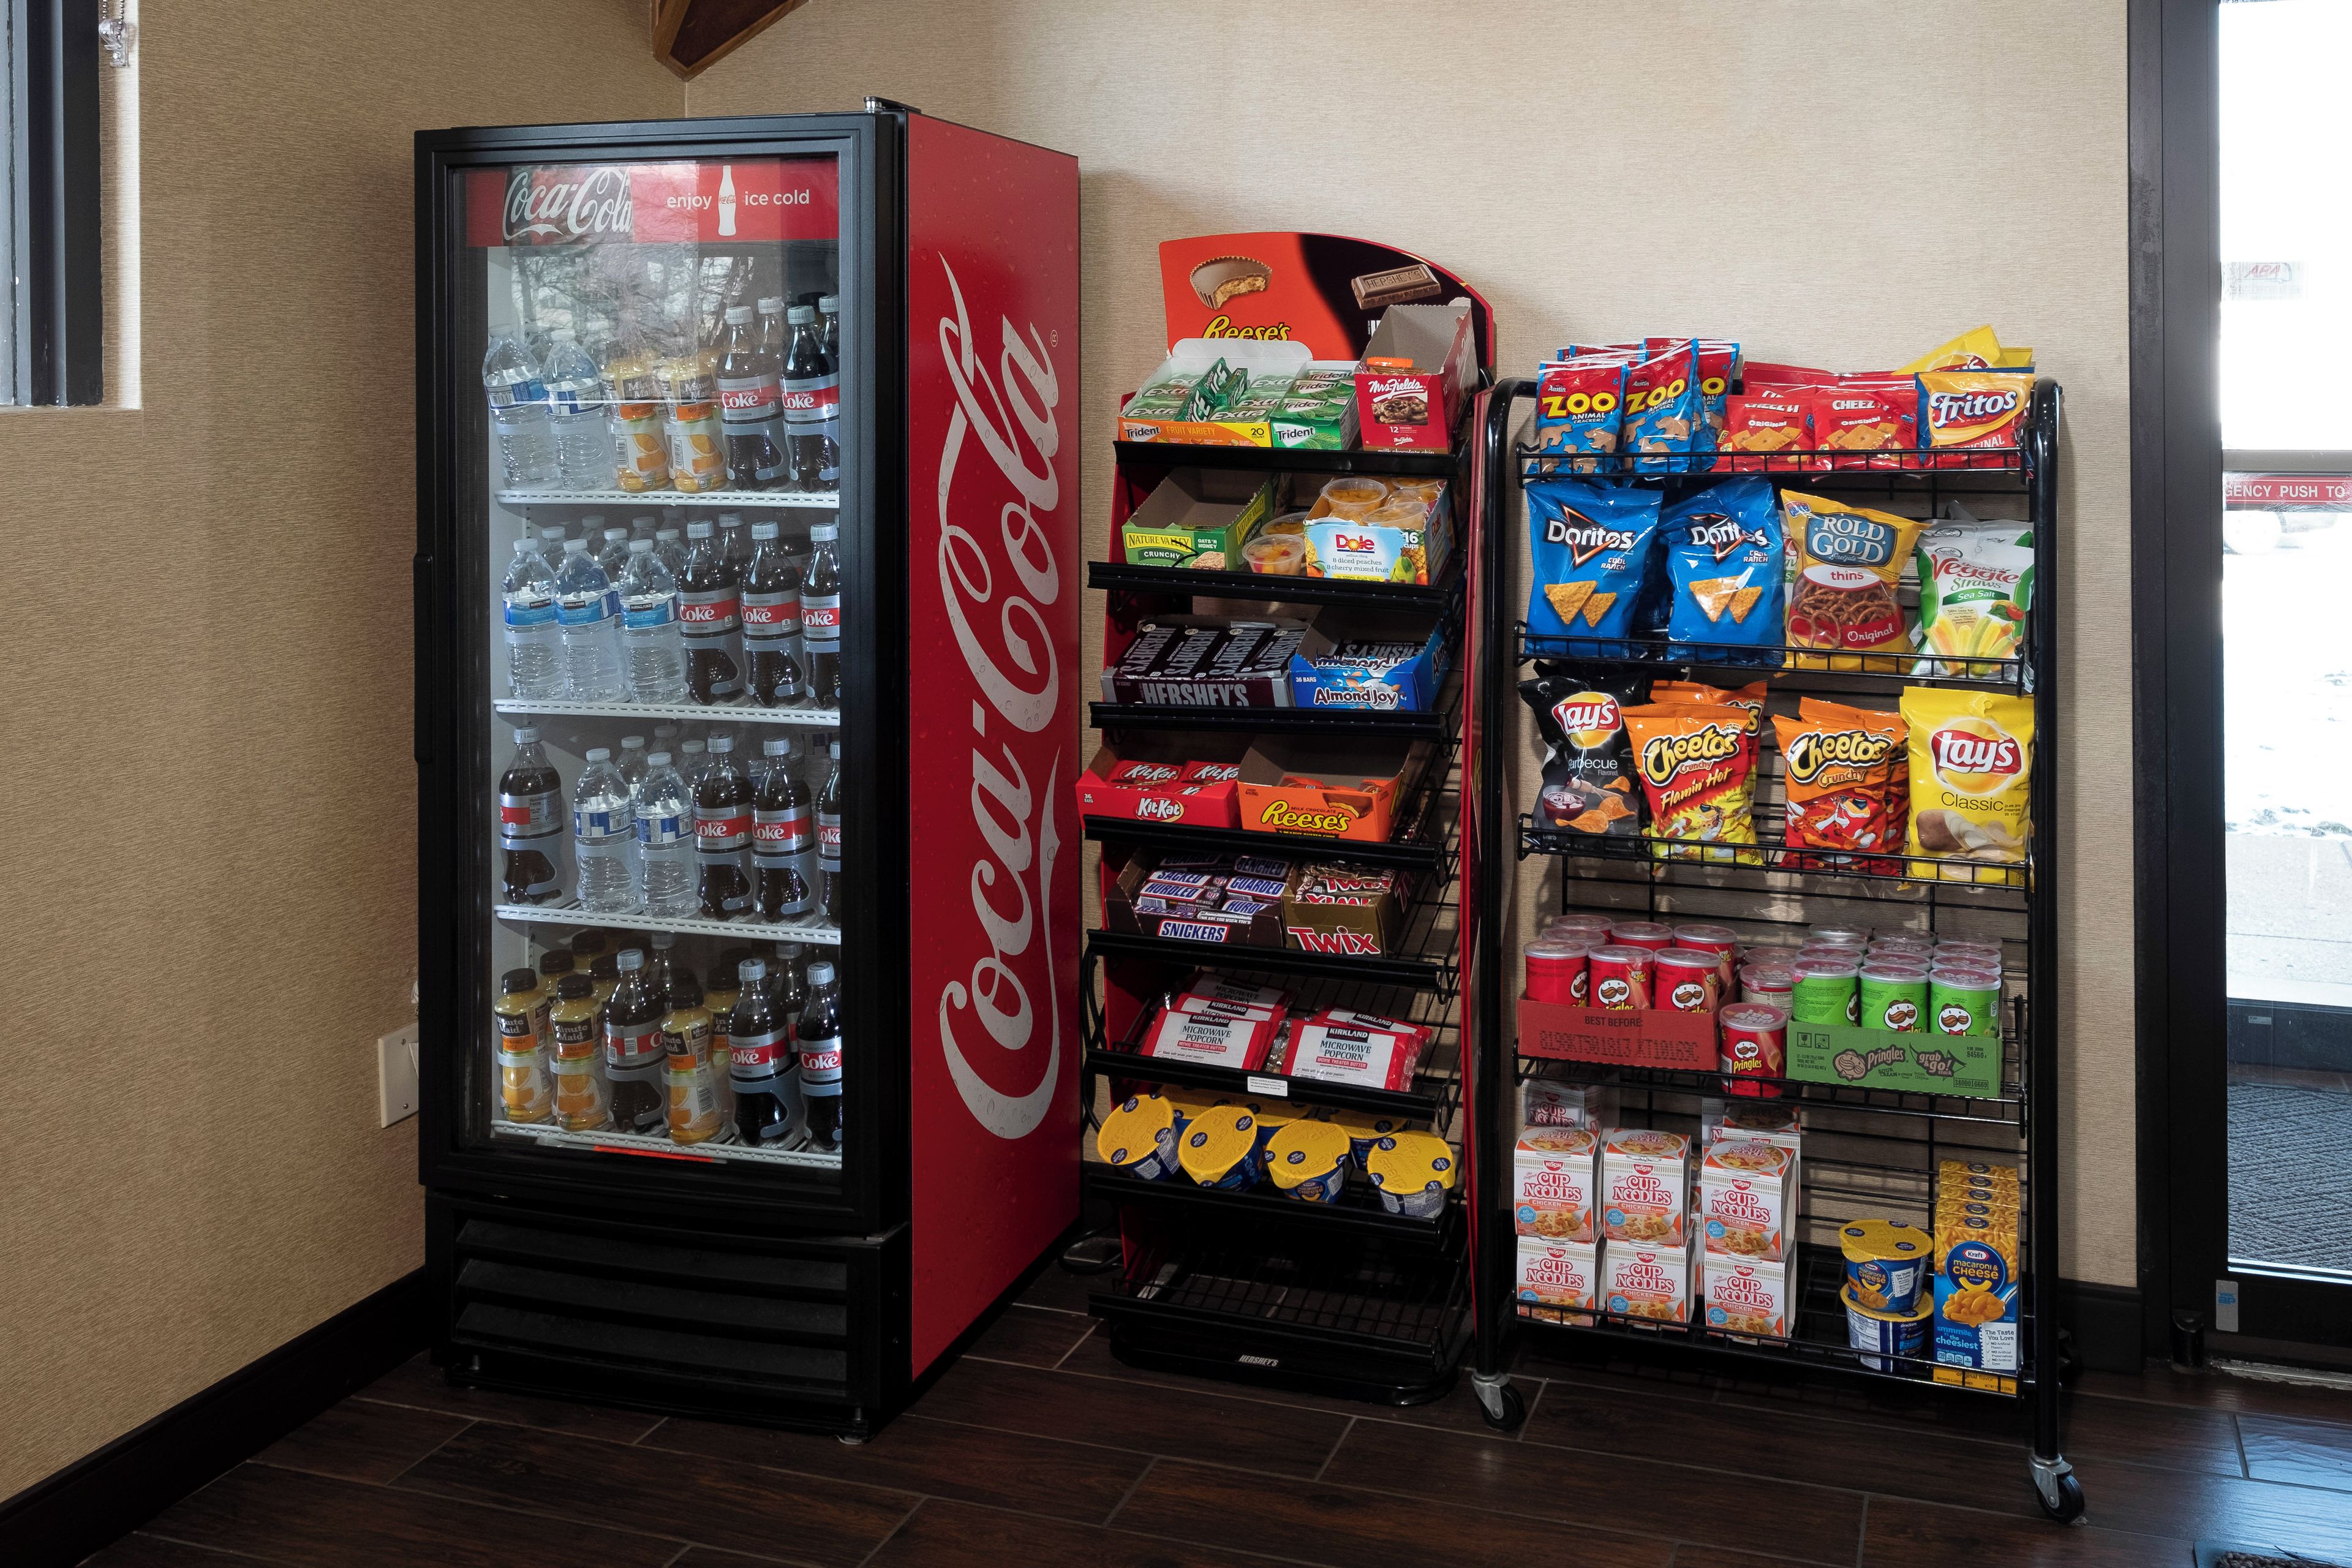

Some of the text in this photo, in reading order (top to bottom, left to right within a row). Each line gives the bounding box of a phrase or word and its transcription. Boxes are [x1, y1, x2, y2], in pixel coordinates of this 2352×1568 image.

[502, 168, 633, 240] Coca-Cola
[667, 189, 810, 210] enjoy ice cold
[1366, 270, 1422, 289] HERSHEY'S
[1202, 315, 1291, 341] Reese's
[1294, 382, 1339, 392] Trident
[722, 391, 759, 409] Coke
[782, 392, 815, 409] Coke
[1281, 401, 1329, 410] Trident
[1541, 392, 1616, 417] ZOO
[1626, 379, 1685, 417] ZOO
[1208, 410, 1267, 420] Extra
[1571, 412, 1606, 421] ANIMAL
[1929, 391, 2018, 429] Fritos
[1124, 426, 1161, 439] Trident
[1166, 426, 1185, 435] FRUIT
[1188, 427, 1216, 435] VARIETY
[1276, 426, 1315, 441] Trident
[2280, 485, 2346, 499] PUSH TO
[1547, 519, 1635, 549] Doritos
[1822, 516, 1885, 541] ROLD
[1128, 535, 1190, 551] NATURE VALLEY
[1335, 533, 1376, 551] Dole
[1403, 532, 1419, 543] 16
[1811, 532, 1884, 563] GOLD
[1830, 570, 1864, 581] thins
[1931, 553, 2020, 584] Veggie
[1950, 577, 2002, 592] Straws
[1957, 593, 1975, 601] Sea
[679, 605, 715, 621] Coke
[740, 606, 772, 623] Coke
[801, 608, 834, 626] Coke
[1847, 623, 1894, 643] Original
[1120, 628, 1177, 672] HERSHEY'S
[1164, 631, 1219, 674] HERSHEY'S
[1209, 630, 1265, 675] HERSHEY'S
[1254, 627, 1307, 669] HERSHEY'S
[938, 250, 1061, 1139] Coca-Cola
[1141, 682, 1250, 706] HERSHEY'S
[1314, 687, 1398, 705] Almond Joy
[1558, 701, 1615, 734] Lay's
[1644, 726, 1739, 784] Cheetos
[1789, 729, 1888, 781] Cheetos
[1939, 732, 2015, 774] Lay's
[1678, 760, 1713, 774] Crunchy
[1817, 769, 1867, 788] Crunchy
[1659, 766, 1733, 810] Flamin' Hot
[1941, 791, 2003, 812] Classic
[1261, 799, 1352, 832] Reese's
[694, 820, 726, 837] Coke
[752, 823, 785, 840] Coke
[1237, 858, 1285, 878] BENCHED
[1157, 870, 1205, 884] SACKED
[1145, 883, 1199, 897] HURDLED
[1230, 877, 1286, 895] GUARDED
[1161, 922, 1225, 942] SNICKERS
[1214, 984, 1261, 1000] MICROWAVE
[1215, 992, 1251, 1005] POPCORN
[1211, 1001, 1248, 1013] KIRKLAND
[1192, 1014, 1230, 1024] KIRKLAND
[1356, 1013, 1392, 1026] KIRKLAND
[1585, 1016, 1643, 1027] BEST BEFORE:
[1182, 1025, 1232, 1038] MICROWAVE
[1185, 1033, 1224, 1045] POPCORN
[1329, 1028, 1368, 1038] KIRKLAND
[728, 1046, 760, 1065] Coke
[1320, 1040, 1372, 1054] MICROWAVE
[1324, 1049, 1364, 1061] POPCORN
[1966, 1050, 1985, 1059] 84560
[801, 1052, 839, 1069] Coke
[1332, 1058, 1349, 1066] THEATER
[1733, 1058, 1762, 1073] Pringles
[1867, 1049, 1904, 1069] Pringles
[1918, 1052, 1942, 1066] grab
[1929, 1059, 1952, 1074] go!
[1539, 1102, 1567, 1116] CUP
[1528, 1110, 1575, 1128] NOODLES
[1730, 1147, 1771, 1158] NOODLES
[1537, 1172, 1570, 1186] CUP
[1626, 1175, 1661, 1191] CUP
[1733, 1180, 1751, 1188] NISSIN
[1523, 1183, 1582, 1202] NOODLES
[1612, 1186, 1672, 1206] NOODLES
[1724, 1190, 1759, 1207] CUP
[1621, 1203, 1651, 1212] CHICKEN
[1711, 1199, 1771, 1223] NOODLES
[1720, 1216, 1750, 1227] CHICKEN
[1967, 1250, 1985, 1259] Kraft
[1539, 1258, 1573, 1275] CUP
[1629, 1263, 1664, 1280] CUP
[1858, 1267, 1882, 1278] macaroni
[1953, 1259, 1992, 1270] macaroni
[1526, 1268, 1585, 1289] NOODLES
[1615, 1273, 1675, 1294] NOODLES
[1727, 1276, 1762, 1292] CUP
[1534, 1284, 1564, 1293] CHICKEN
[1624, 1289, 1654, 1299] CHICKEN
[1713, 1286, 1774, 1308] NOODLES
[1722, 1302, 1754, 1313] CHICKEN
[1936, 1336, 1978, 1350] cheesiest
[1238, 1354, 1280, 1367] HERSHEY'S
